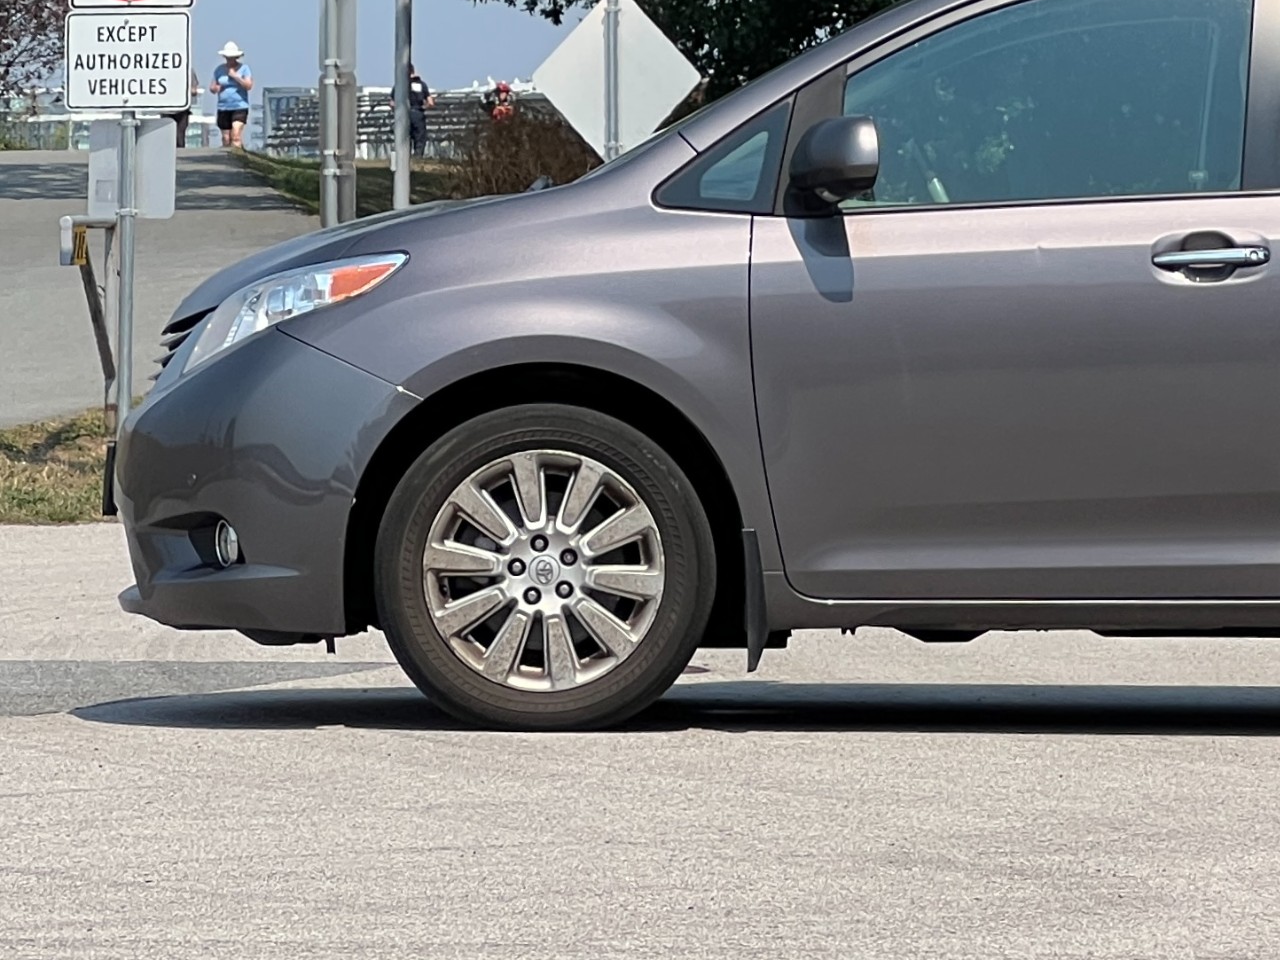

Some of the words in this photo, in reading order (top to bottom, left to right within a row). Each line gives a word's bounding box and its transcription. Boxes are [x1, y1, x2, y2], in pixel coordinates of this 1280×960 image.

[97, 25, 157, 42] EXCEPT
[74, 52, 182, 70] AUTHORIZED
[88, 78, 167, 95] VEHICLES
